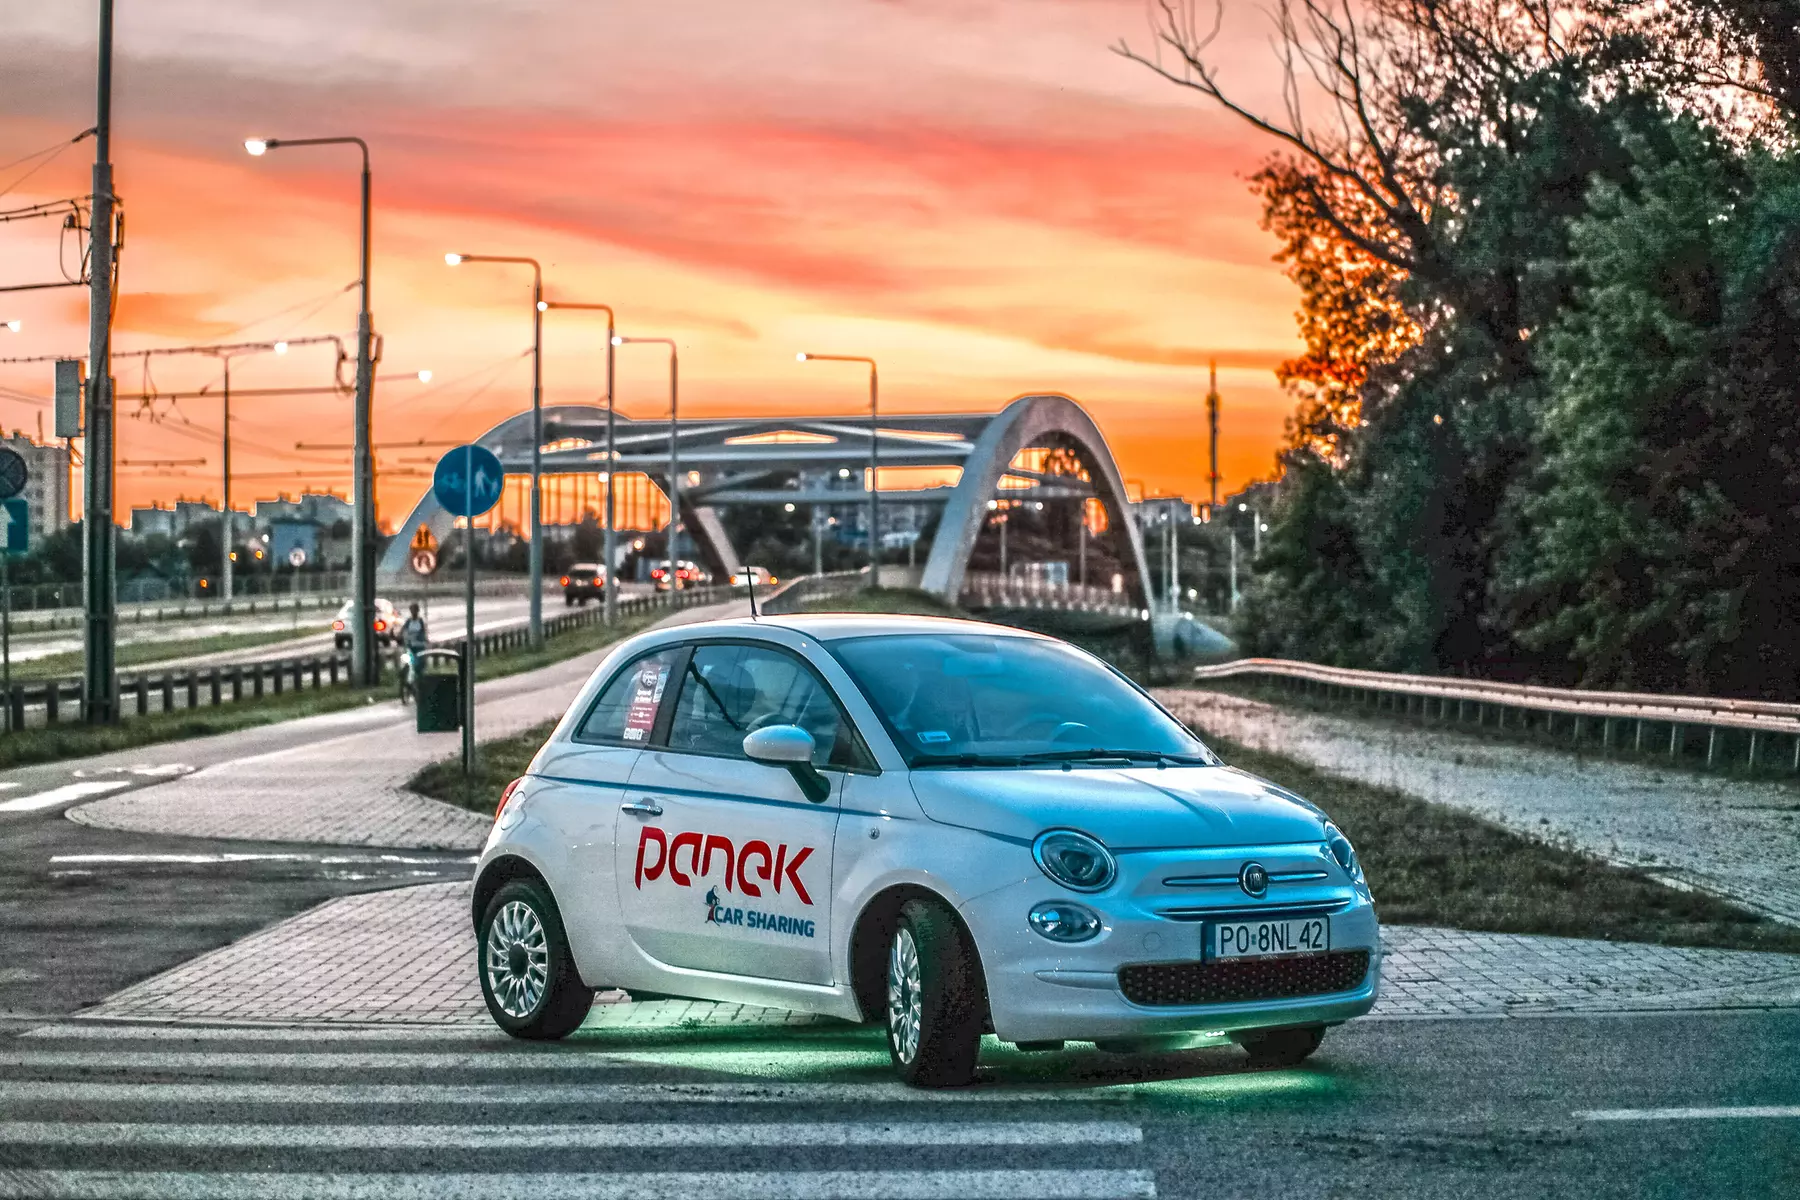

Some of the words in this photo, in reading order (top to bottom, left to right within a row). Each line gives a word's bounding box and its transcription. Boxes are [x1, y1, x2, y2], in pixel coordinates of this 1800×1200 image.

[635, 826, 815, 906] panek
[714, 906, 743, 926] CAR
[747, 911, 815, 938] SHARING
[1220, 925, 1249, 954] PO
